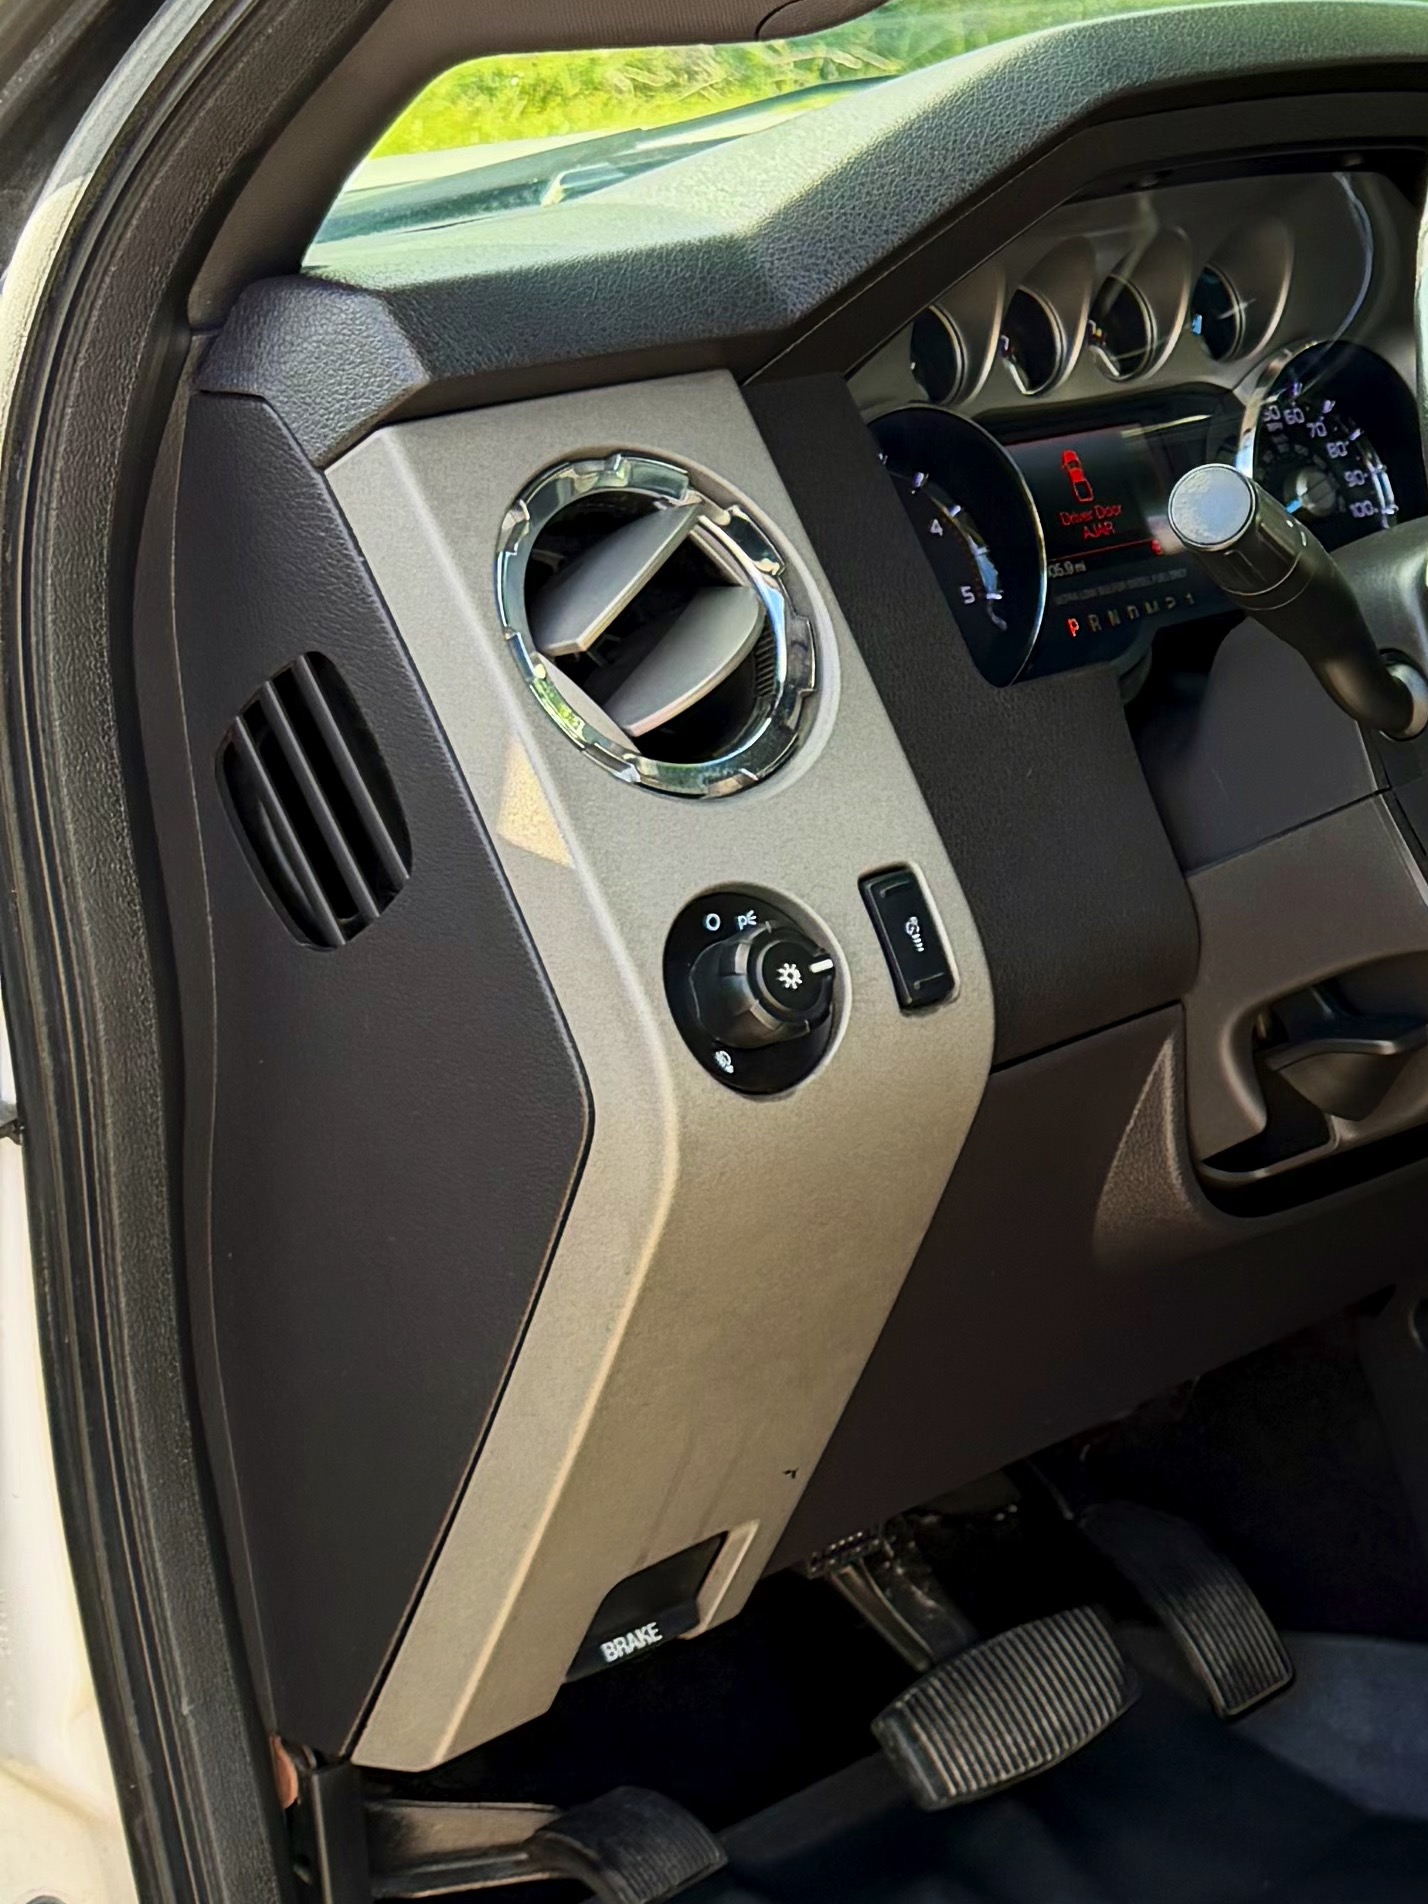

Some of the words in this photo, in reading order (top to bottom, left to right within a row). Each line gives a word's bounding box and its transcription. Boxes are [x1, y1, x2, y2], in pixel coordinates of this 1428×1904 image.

[1283, 408, 1305, 425] 60
[1306, 422, 1328, 438] 70
[1326, 441, 1348, 459] 80
[1344, 470, 1365, 487] 90
[1095, 505, 1121, 519] Door
[1349, 500, 1374, 518] 100
[930, 519, 943, 536] 4
[1083, 521, 1115, 539] AJAR
[960, 586, 975, 604] 5
[600, 1622, 663, 1663] BRAKE
